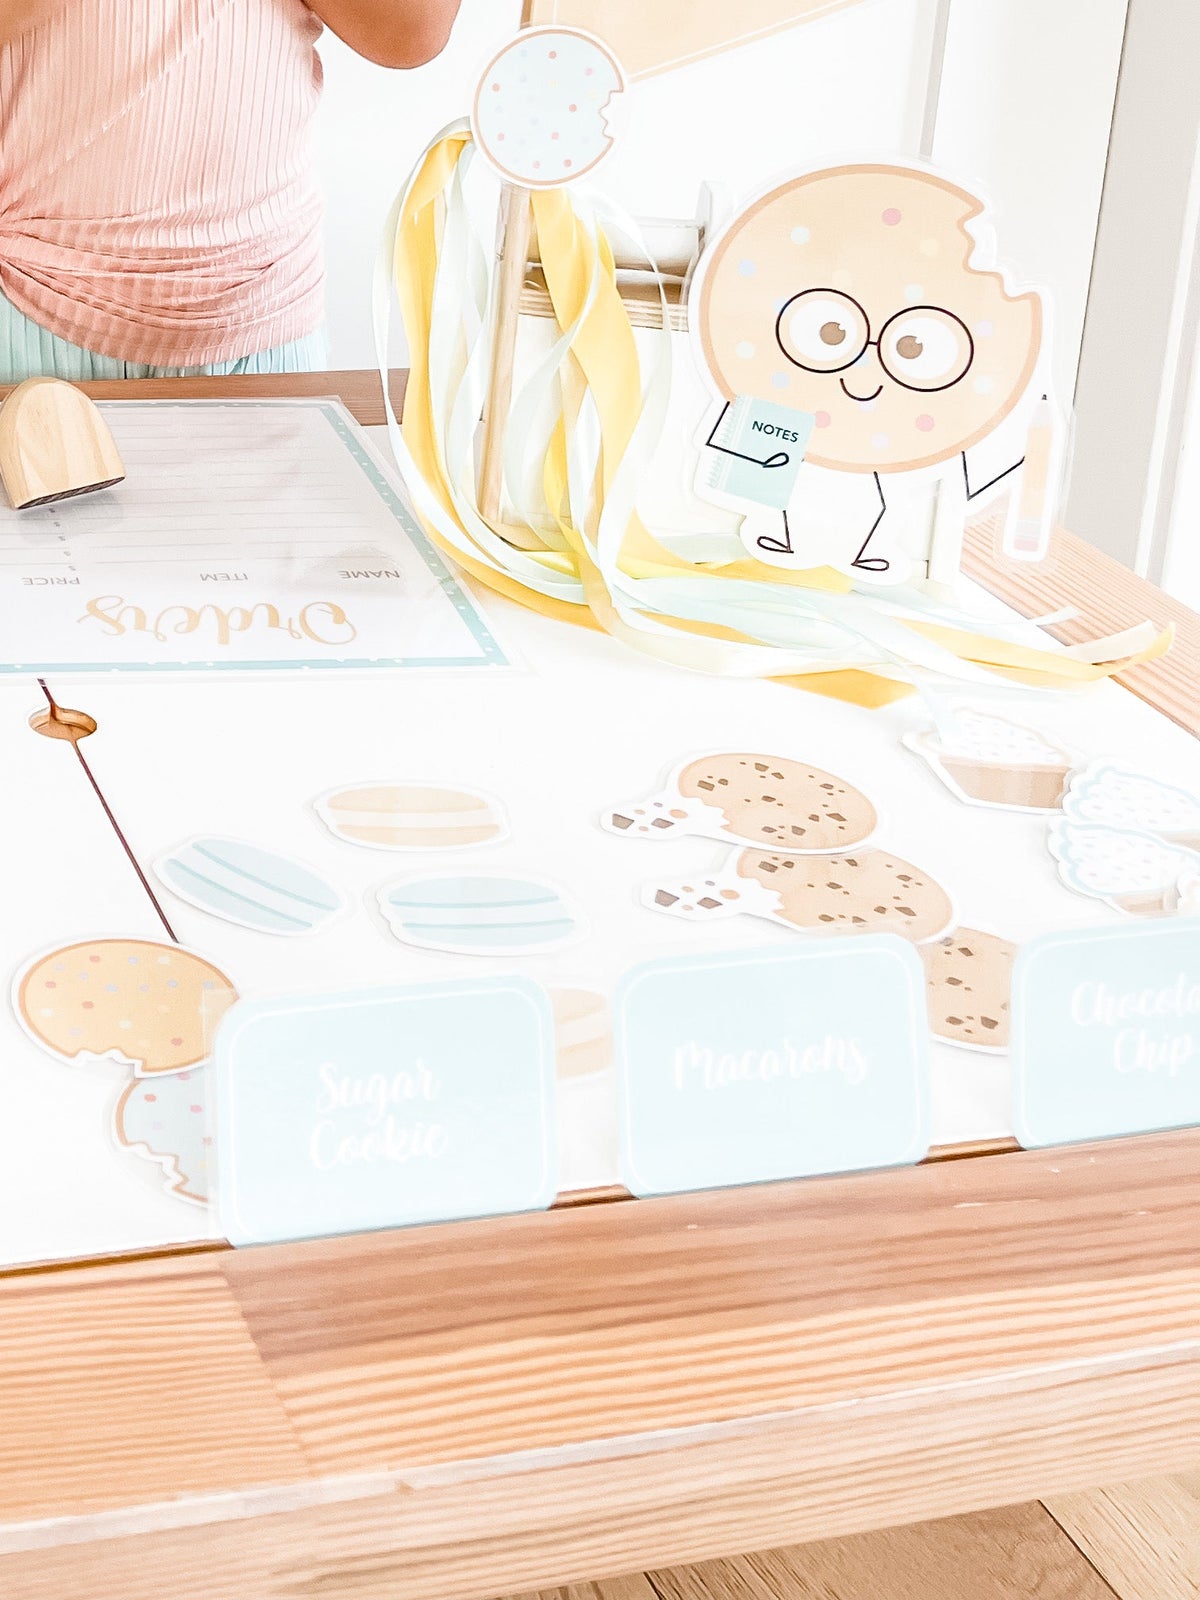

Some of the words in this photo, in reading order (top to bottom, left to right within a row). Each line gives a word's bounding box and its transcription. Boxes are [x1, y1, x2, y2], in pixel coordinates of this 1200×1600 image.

[751, 420, 799, 443] NOTES
[23, 575, 81, 587] PRICE
[199, 571, 249, 583] ITEM
[338, 569, 401, 581] NAME
[75, 594, 358, 647] Orders
[673, 1030, 872, 1092] Macarons
[1113, 1028, 1194, 1078] Chip
[315, 1055, 443, 1127] Sugar
[309, 1115, 450, 1170] Cookie
